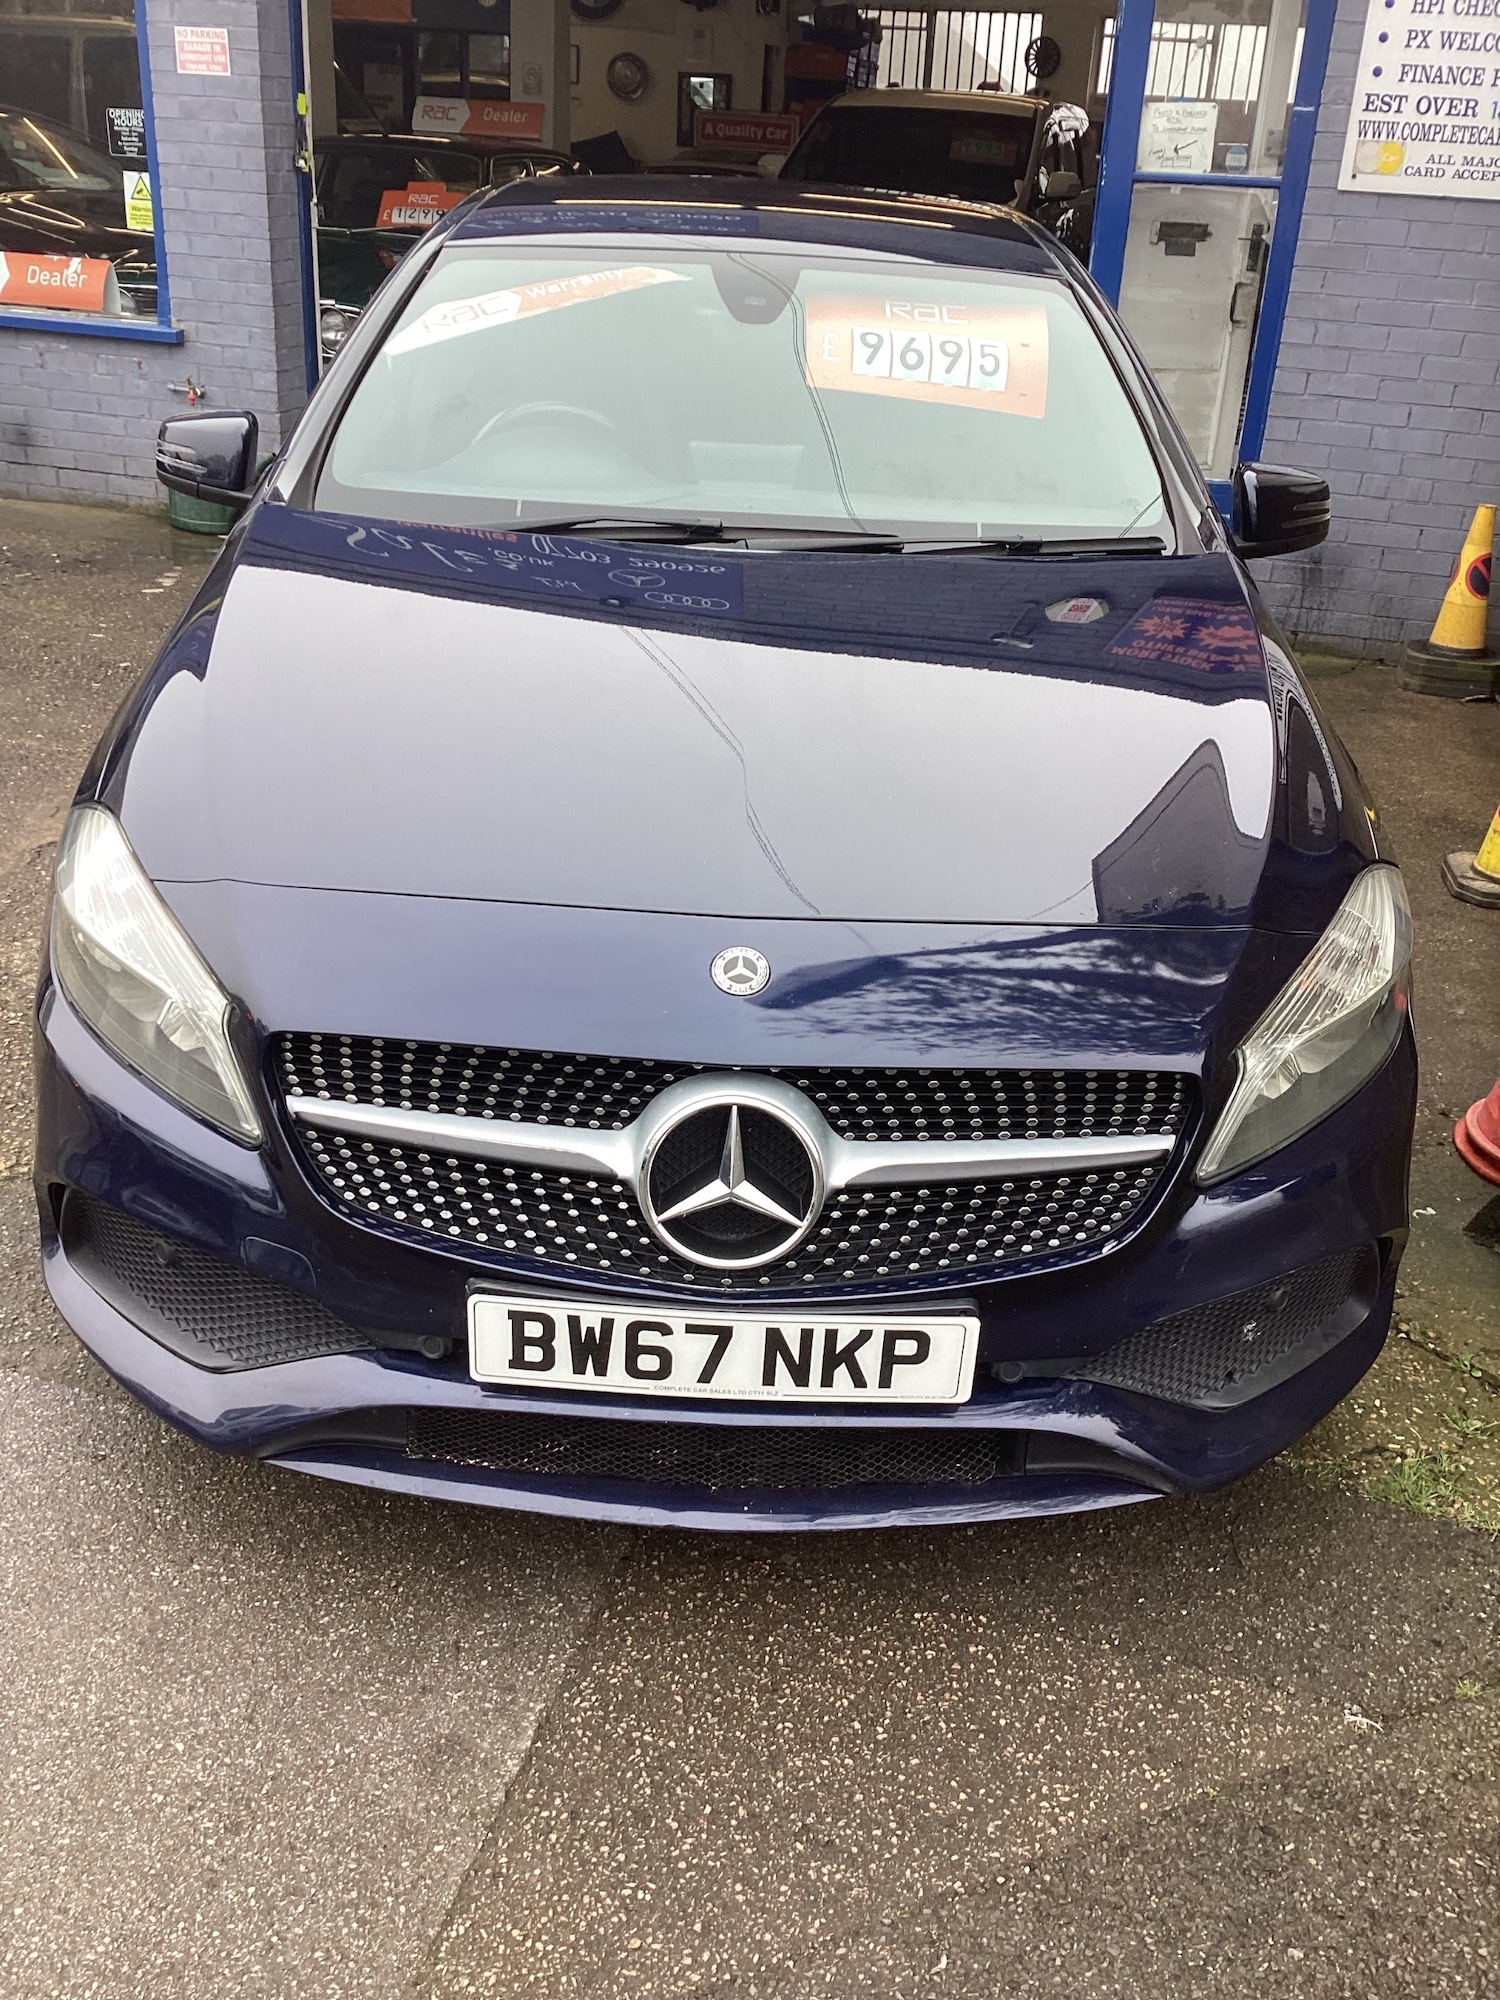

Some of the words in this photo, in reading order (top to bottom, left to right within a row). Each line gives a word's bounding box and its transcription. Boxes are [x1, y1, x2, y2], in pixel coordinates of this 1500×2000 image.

[1411, 0, 1445, 14] HPI
[177, 29, 188, 39] NO
[190, 30, 226, 41] PARKING
[1404, 29, 1433, 49] PX
[1398, 63, 1486, 86] FINANCE
[483, 107, 528, 123] Dealer
[1362, 93, 1408, 114] EST
[1416, 95, 1479, 118] OVER
[1492, 100, 1500, 120] 1
[114, 118, 143, 127] HOURS
[704, 122, 713, 135] A
[716, 123, 763, 141] Quality
[766, 127, 788, 140] Car
[1426, 154, 1456, 166] ALL
[1404, 165, 1446, 179] CARD
[1451, 168, 1500, 182] ACCEP
[27, 265, 88, 288] Dealer
[525, 269, 624, 299] Warranty
[859, 331, 1000, 377] 9695
[507, 1309, 734, 1384] BW67
[762, 1327, 931, 1389] NKP
[654, 1385, 692, 1393] COMPLETE
